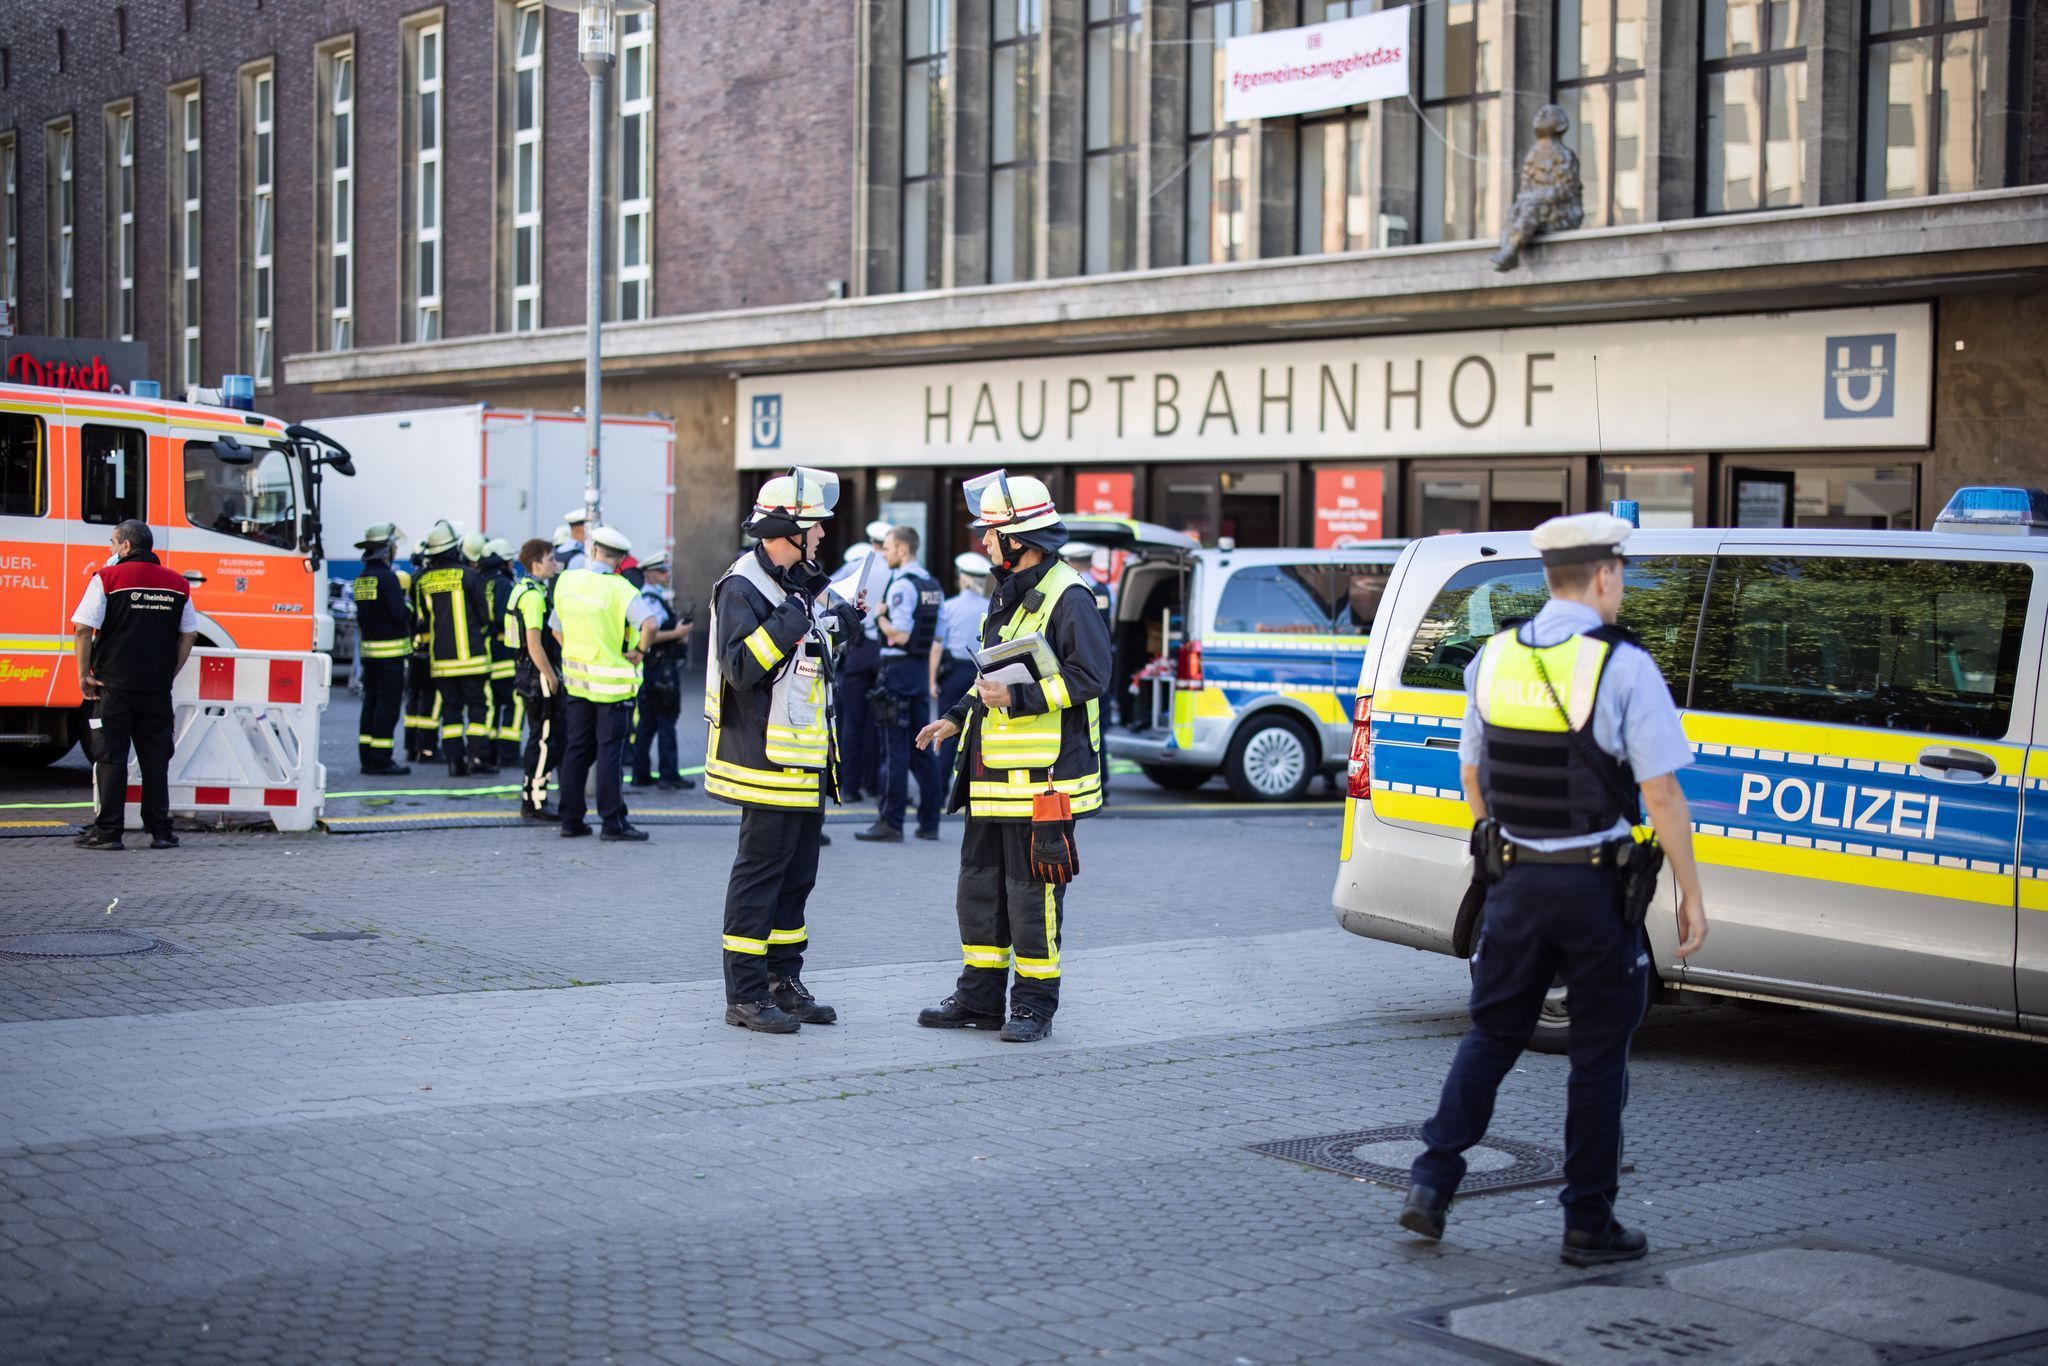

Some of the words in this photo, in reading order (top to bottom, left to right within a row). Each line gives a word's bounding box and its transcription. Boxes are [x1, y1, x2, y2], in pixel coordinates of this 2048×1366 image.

[8, 352, 109, 391] Ditsch
[925, 353, 1555, 444] HAUPTBAHNHOF
[1493, 678, 1567, 709] POLIZEI
[1738, 773, 1940, 840] POLIZEI
